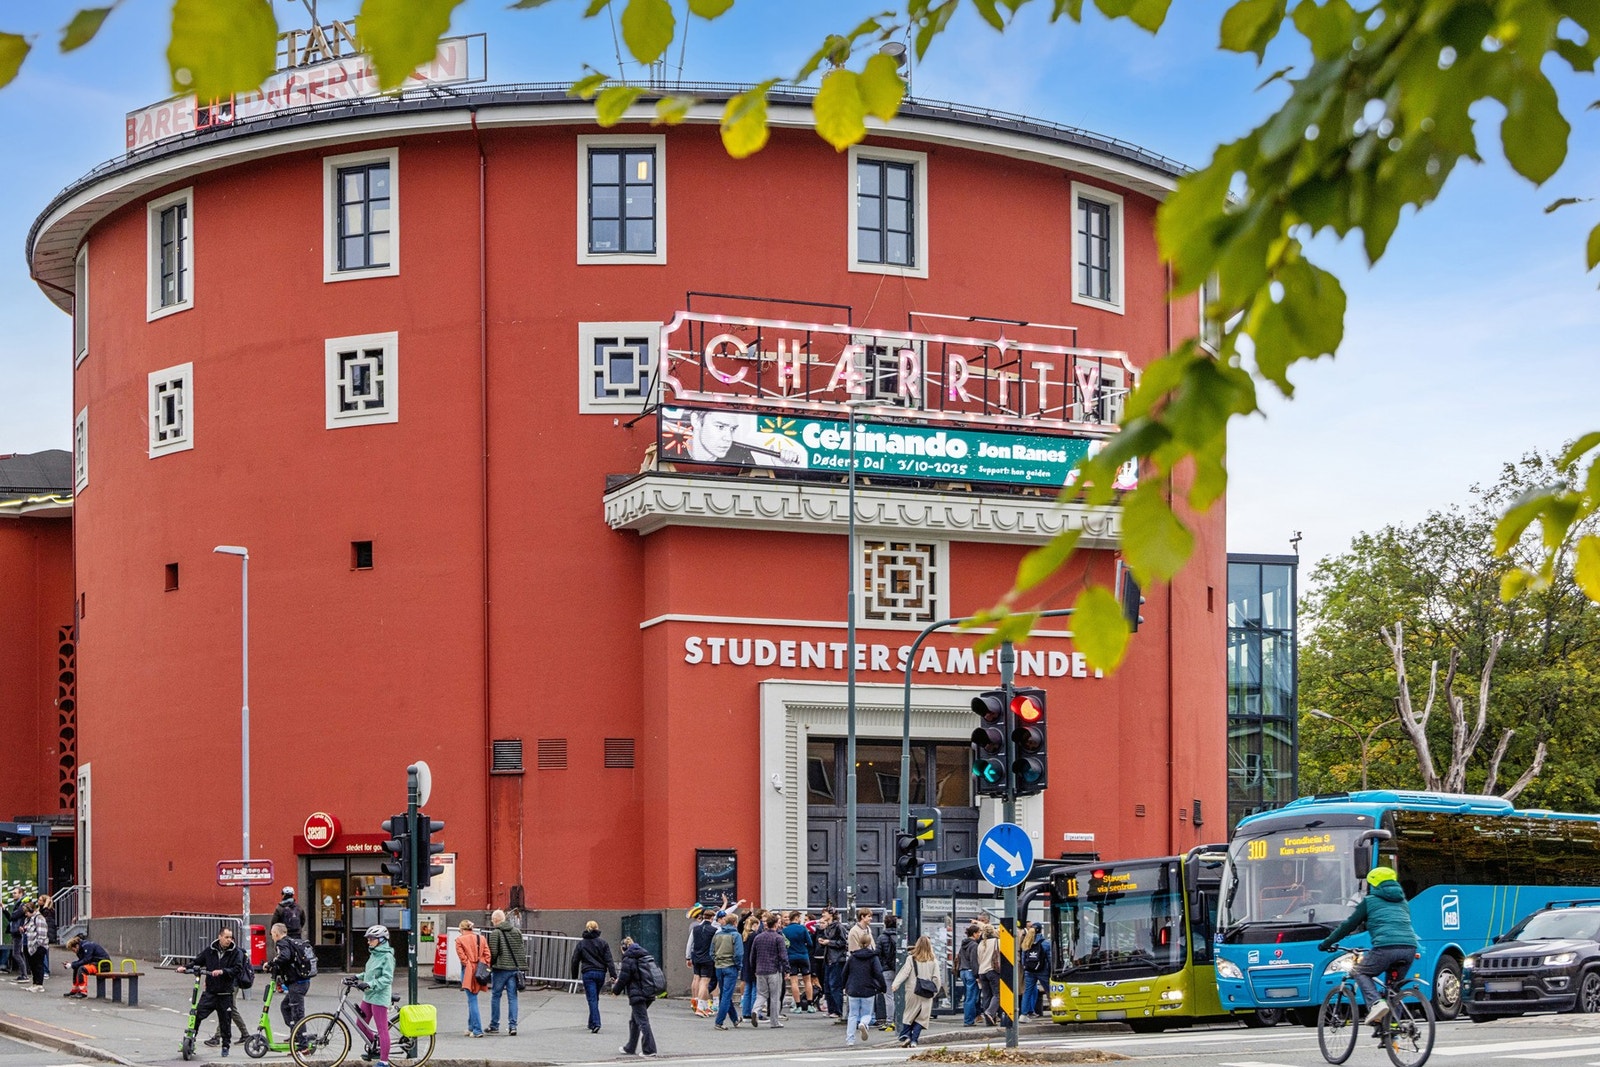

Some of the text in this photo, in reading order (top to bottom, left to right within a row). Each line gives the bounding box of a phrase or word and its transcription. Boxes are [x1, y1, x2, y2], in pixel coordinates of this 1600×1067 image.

[126, 100, 190, 148] BARE
[802, 422, 1067, 463] Cezinando Jon Ranes
[863, 456, 885, 470] Dal
[897, 460, 968, 475] 3/10-2025
[978, 465, 1010, 476] Support:
[684, 636, 1103, 678] STUDENTERSAMFUNDE
[364, 843, 372, 851] for
[1247, 834, 1331, 860] 310 Trondheim S
[1280, 844, 1336, 855] Kun avstigning
[1067, 878, 1078, 897] 11
[1109, 882, 1137, 892] sentrum
